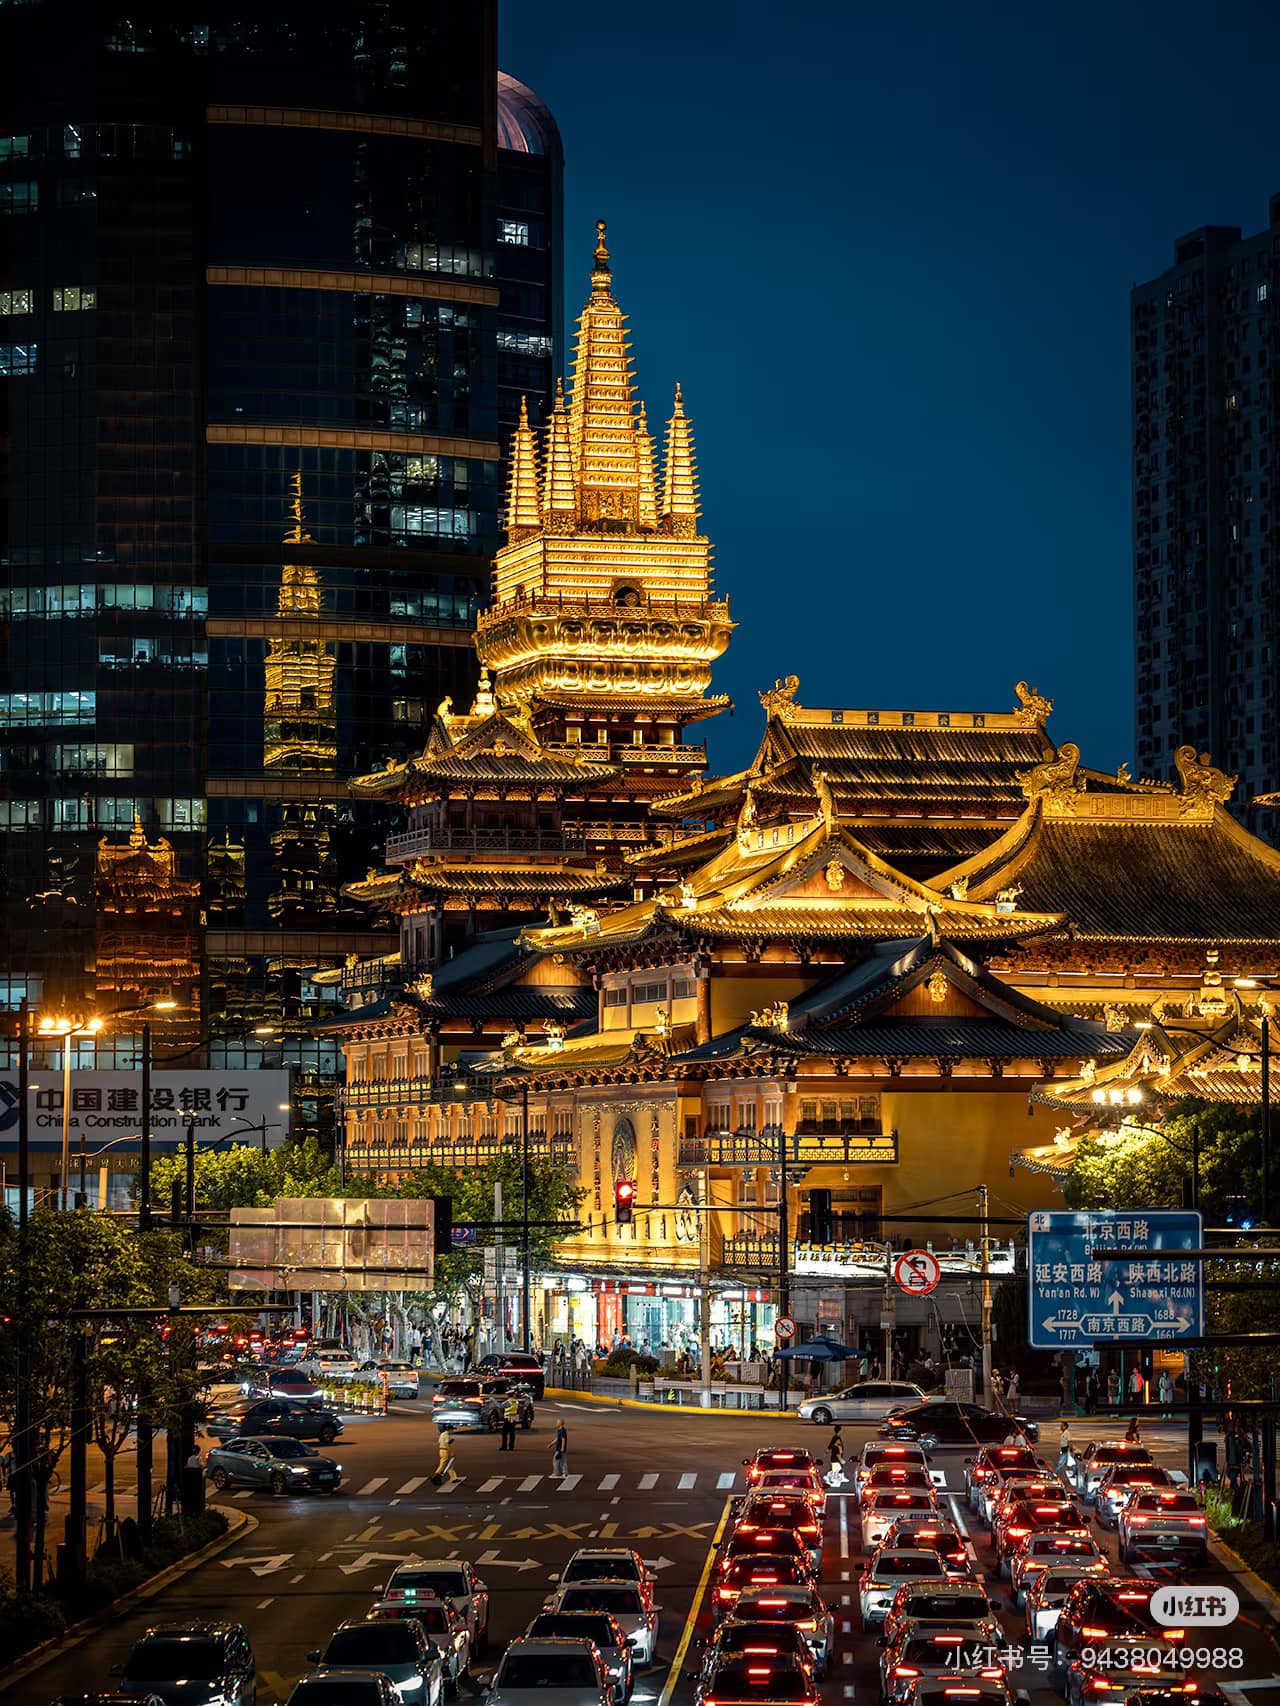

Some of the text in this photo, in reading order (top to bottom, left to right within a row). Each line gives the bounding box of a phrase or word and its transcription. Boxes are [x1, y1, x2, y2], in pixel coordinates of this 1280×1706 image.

[36, 1087, 249, 1111] 中国建设银行
[36, 1114, 80, 1127] Chia
[85, 1114, 177, 1127] Constrution
[1034, 1214, 1045, 1224] 北
[1082, 1220, 1149, 1240] 北京西路
[1035, 1263, 1103, 1283] 延安西路
[1128, 1263, 1196, 1283] 陕西北路
[1038, 1287, 1071, 1298] Yan'an
[1130, 1287, 1168, 1298] Shaanxi
[1057, 1309, 1078, 1320] 1728
[1154, 1309, 1174, 1320] 1688
[1087, 1317, 1145, 1333] 南京西路
[1059, 1329, 1076, 1340] 1717
[1156, 1329, 1175, 1340] 1661
